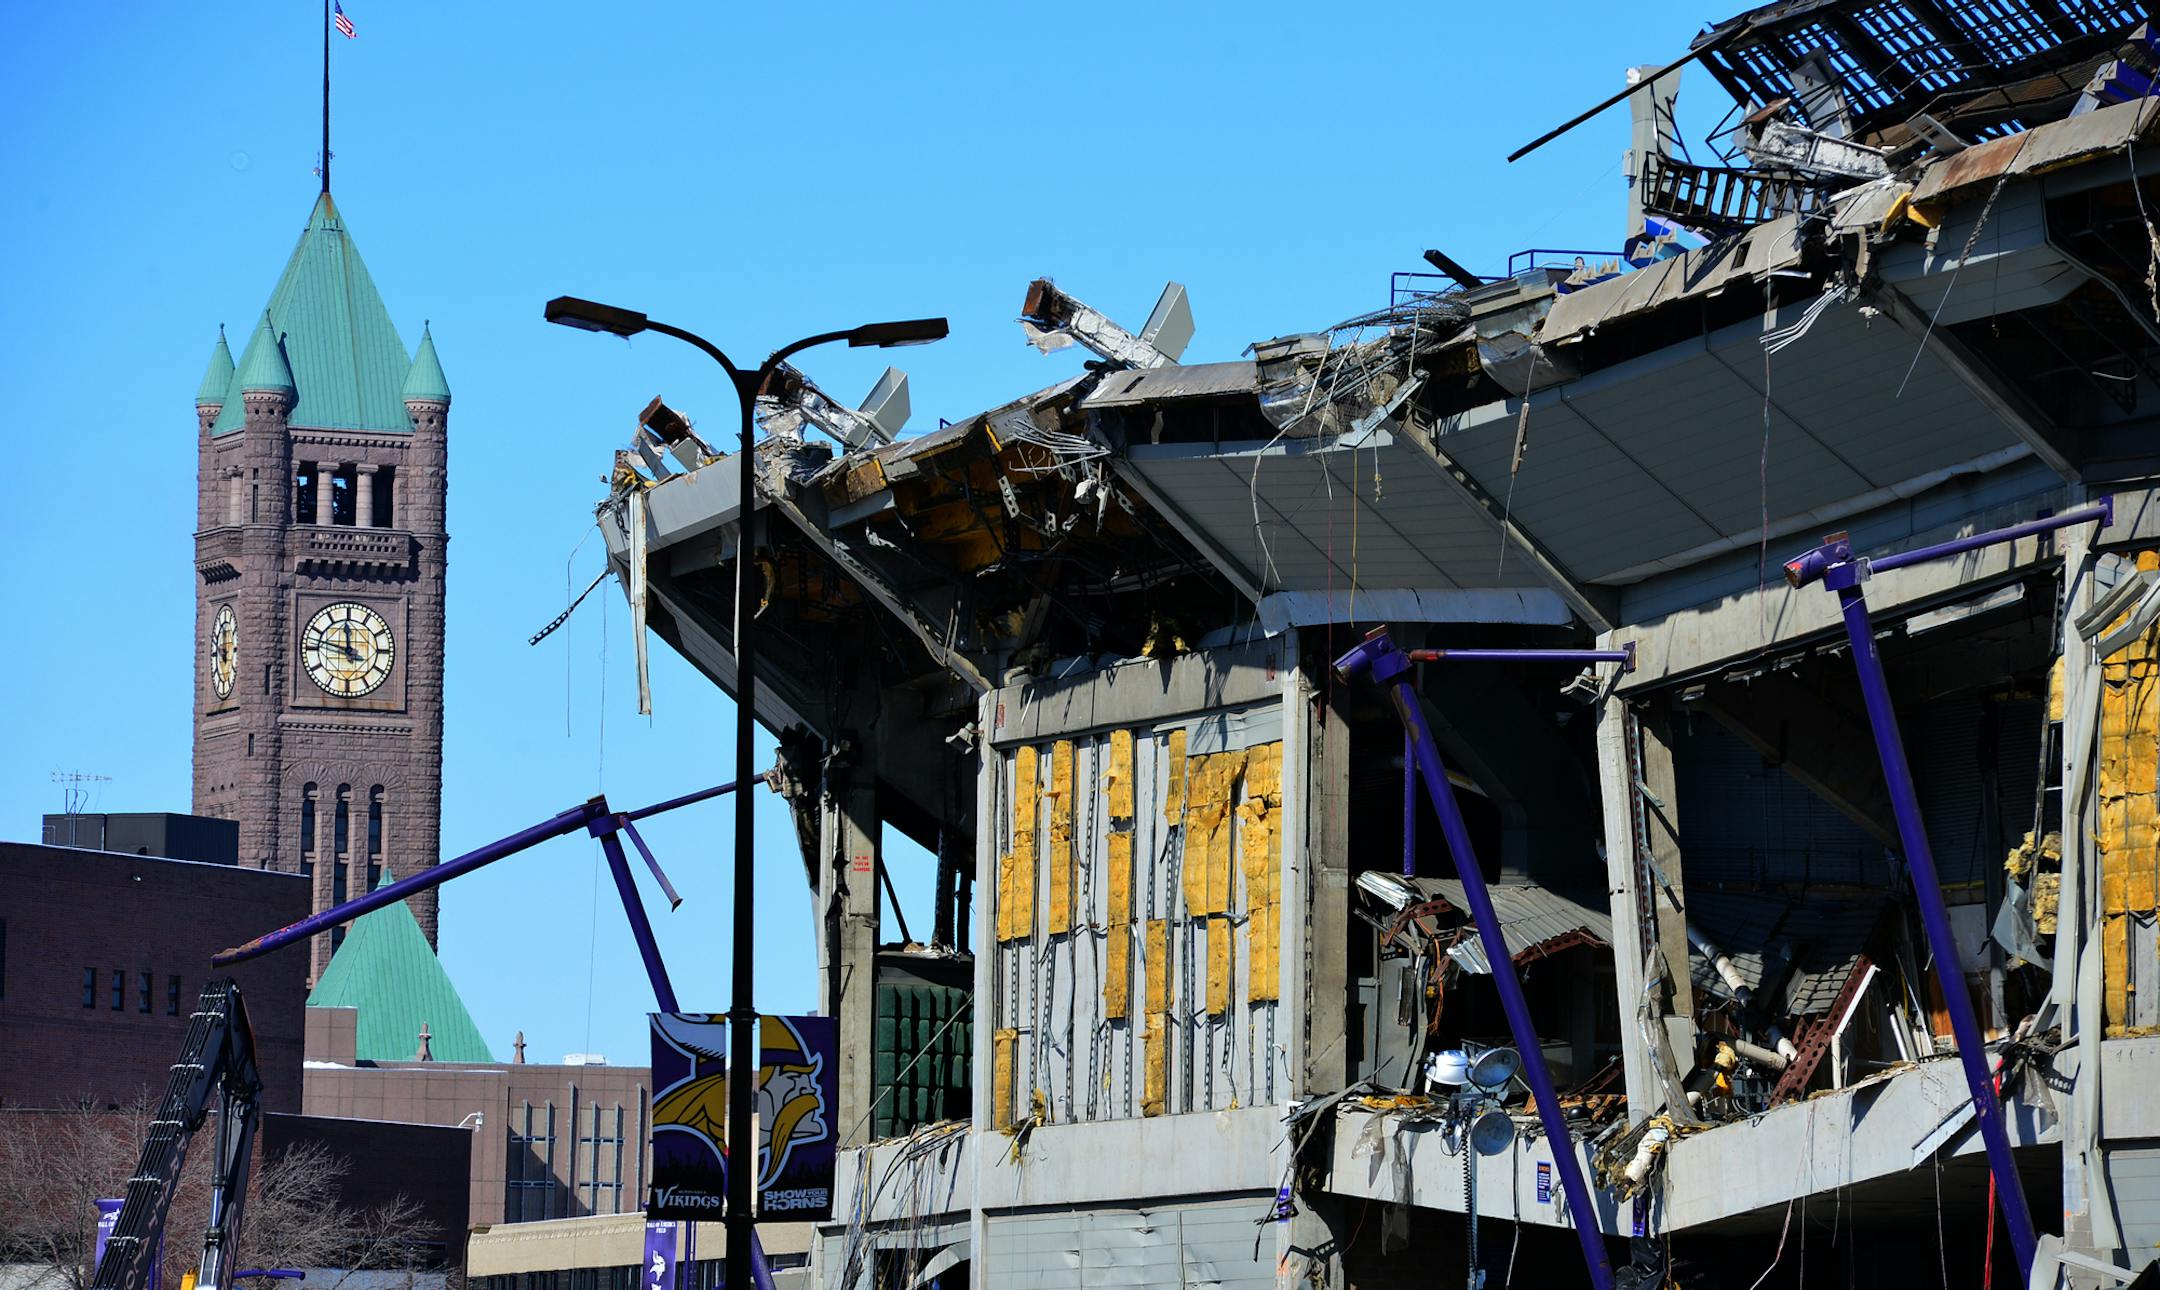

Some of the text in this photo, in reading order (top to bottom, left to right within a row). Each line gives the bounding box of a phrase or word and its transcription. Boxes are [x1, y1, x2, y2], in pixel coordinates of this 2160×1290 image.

[764, 1189, 807, 1200] SHOW
[764, 1197, 828, 1211] HORNS
[122, 1135, 188, 1290] FRATTALO
